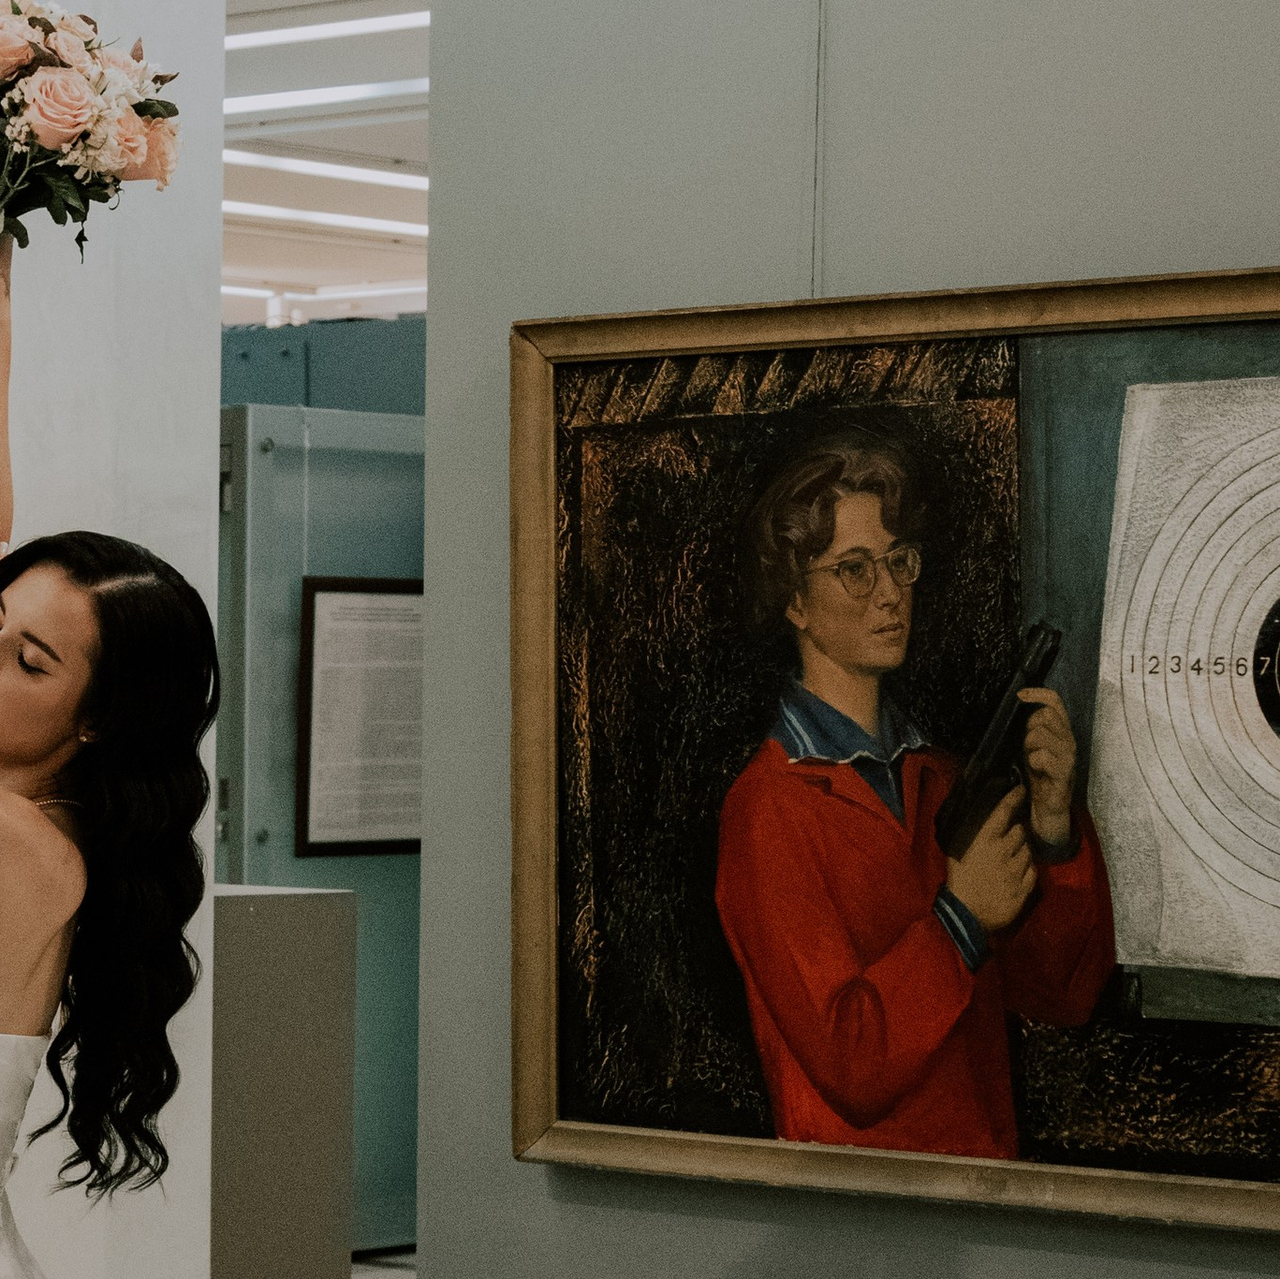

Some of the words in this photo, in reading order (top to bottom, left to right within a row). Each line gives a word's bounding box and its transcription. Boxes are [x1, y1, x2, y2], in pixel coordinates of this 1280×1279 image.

[1148, 655, 1160, 674] 2
[1170, 655, 1182, 673] 3
[1190, 658, 1203, 676] 4
[1213, 657, 1225, 675] 5
[1236, 657, 1248, 676] 6
[1260, 656, 1271, 676] 7
